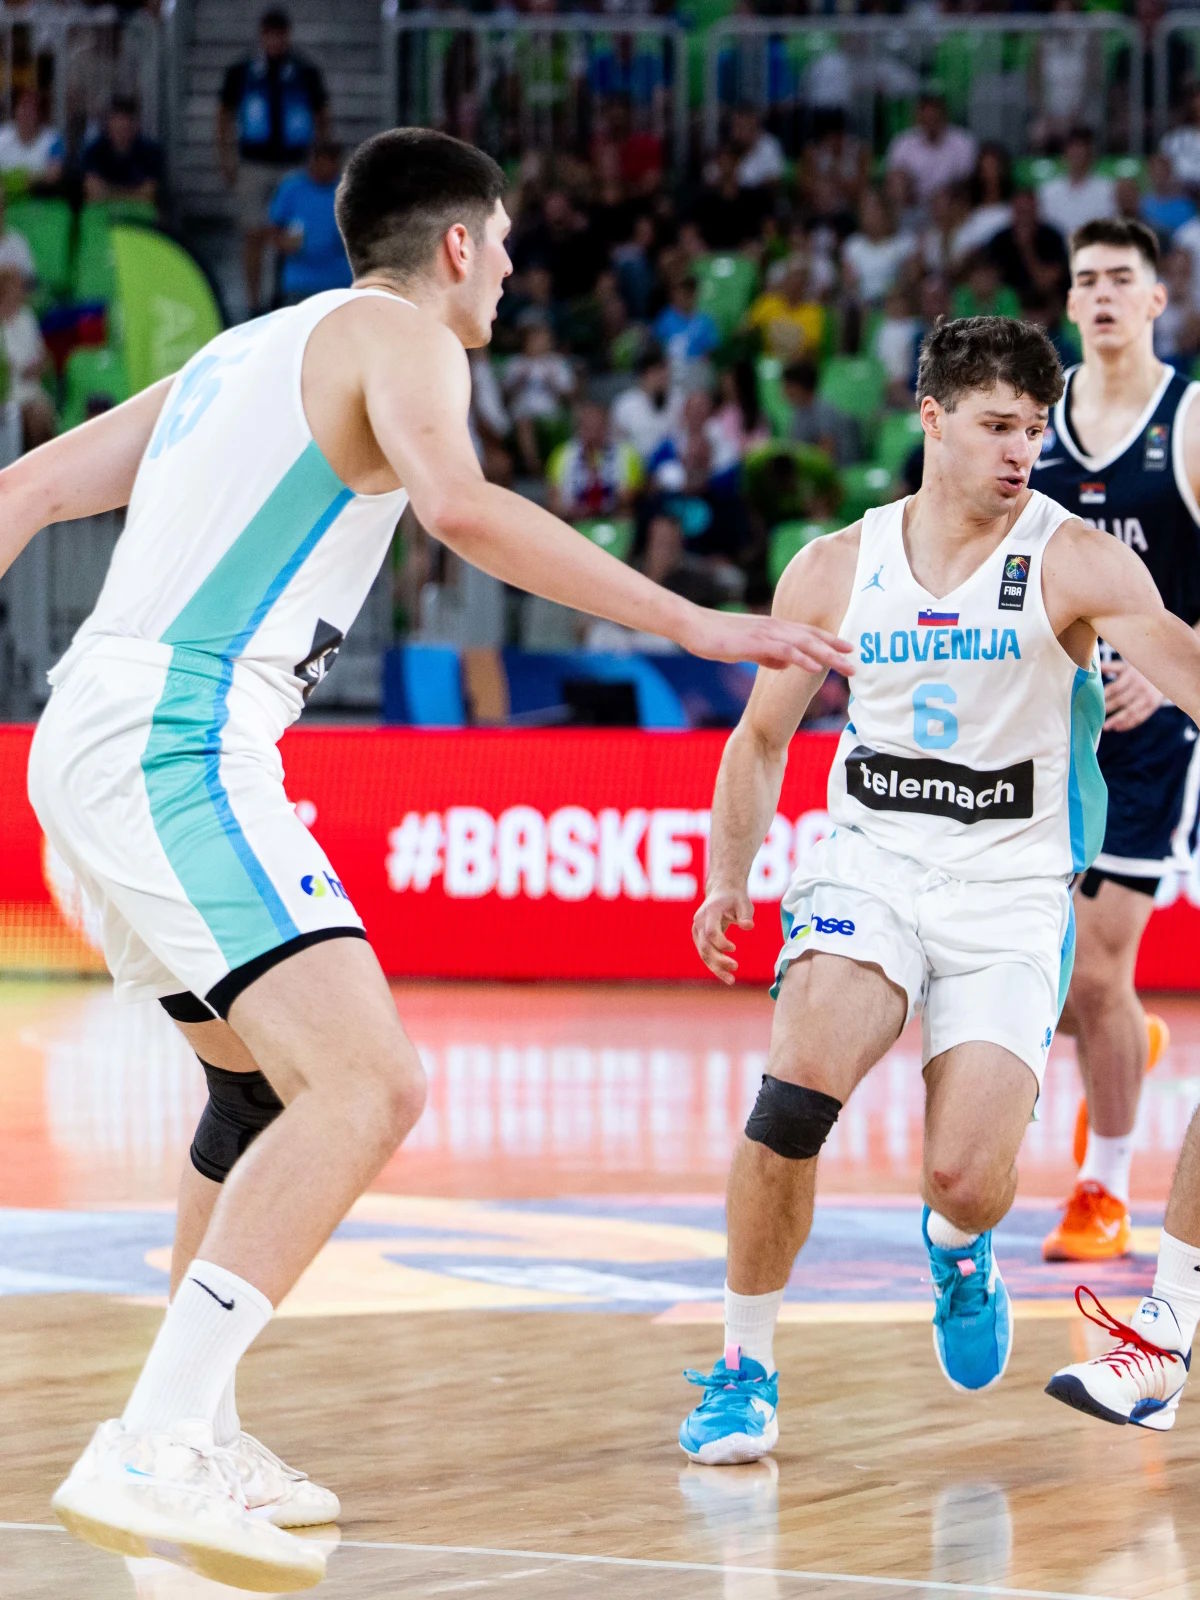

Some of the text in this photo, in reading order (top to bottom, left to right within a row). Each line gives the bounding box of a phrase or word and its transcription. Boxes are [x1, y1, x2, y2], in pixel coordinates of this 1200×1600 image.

[1003, 585, 1022, 597] FIBA
[860, 628, 1021, 664] SLOVENIJA
[912, 683, 959, 750] 6
[859, 761, 1015, 811] telemach
